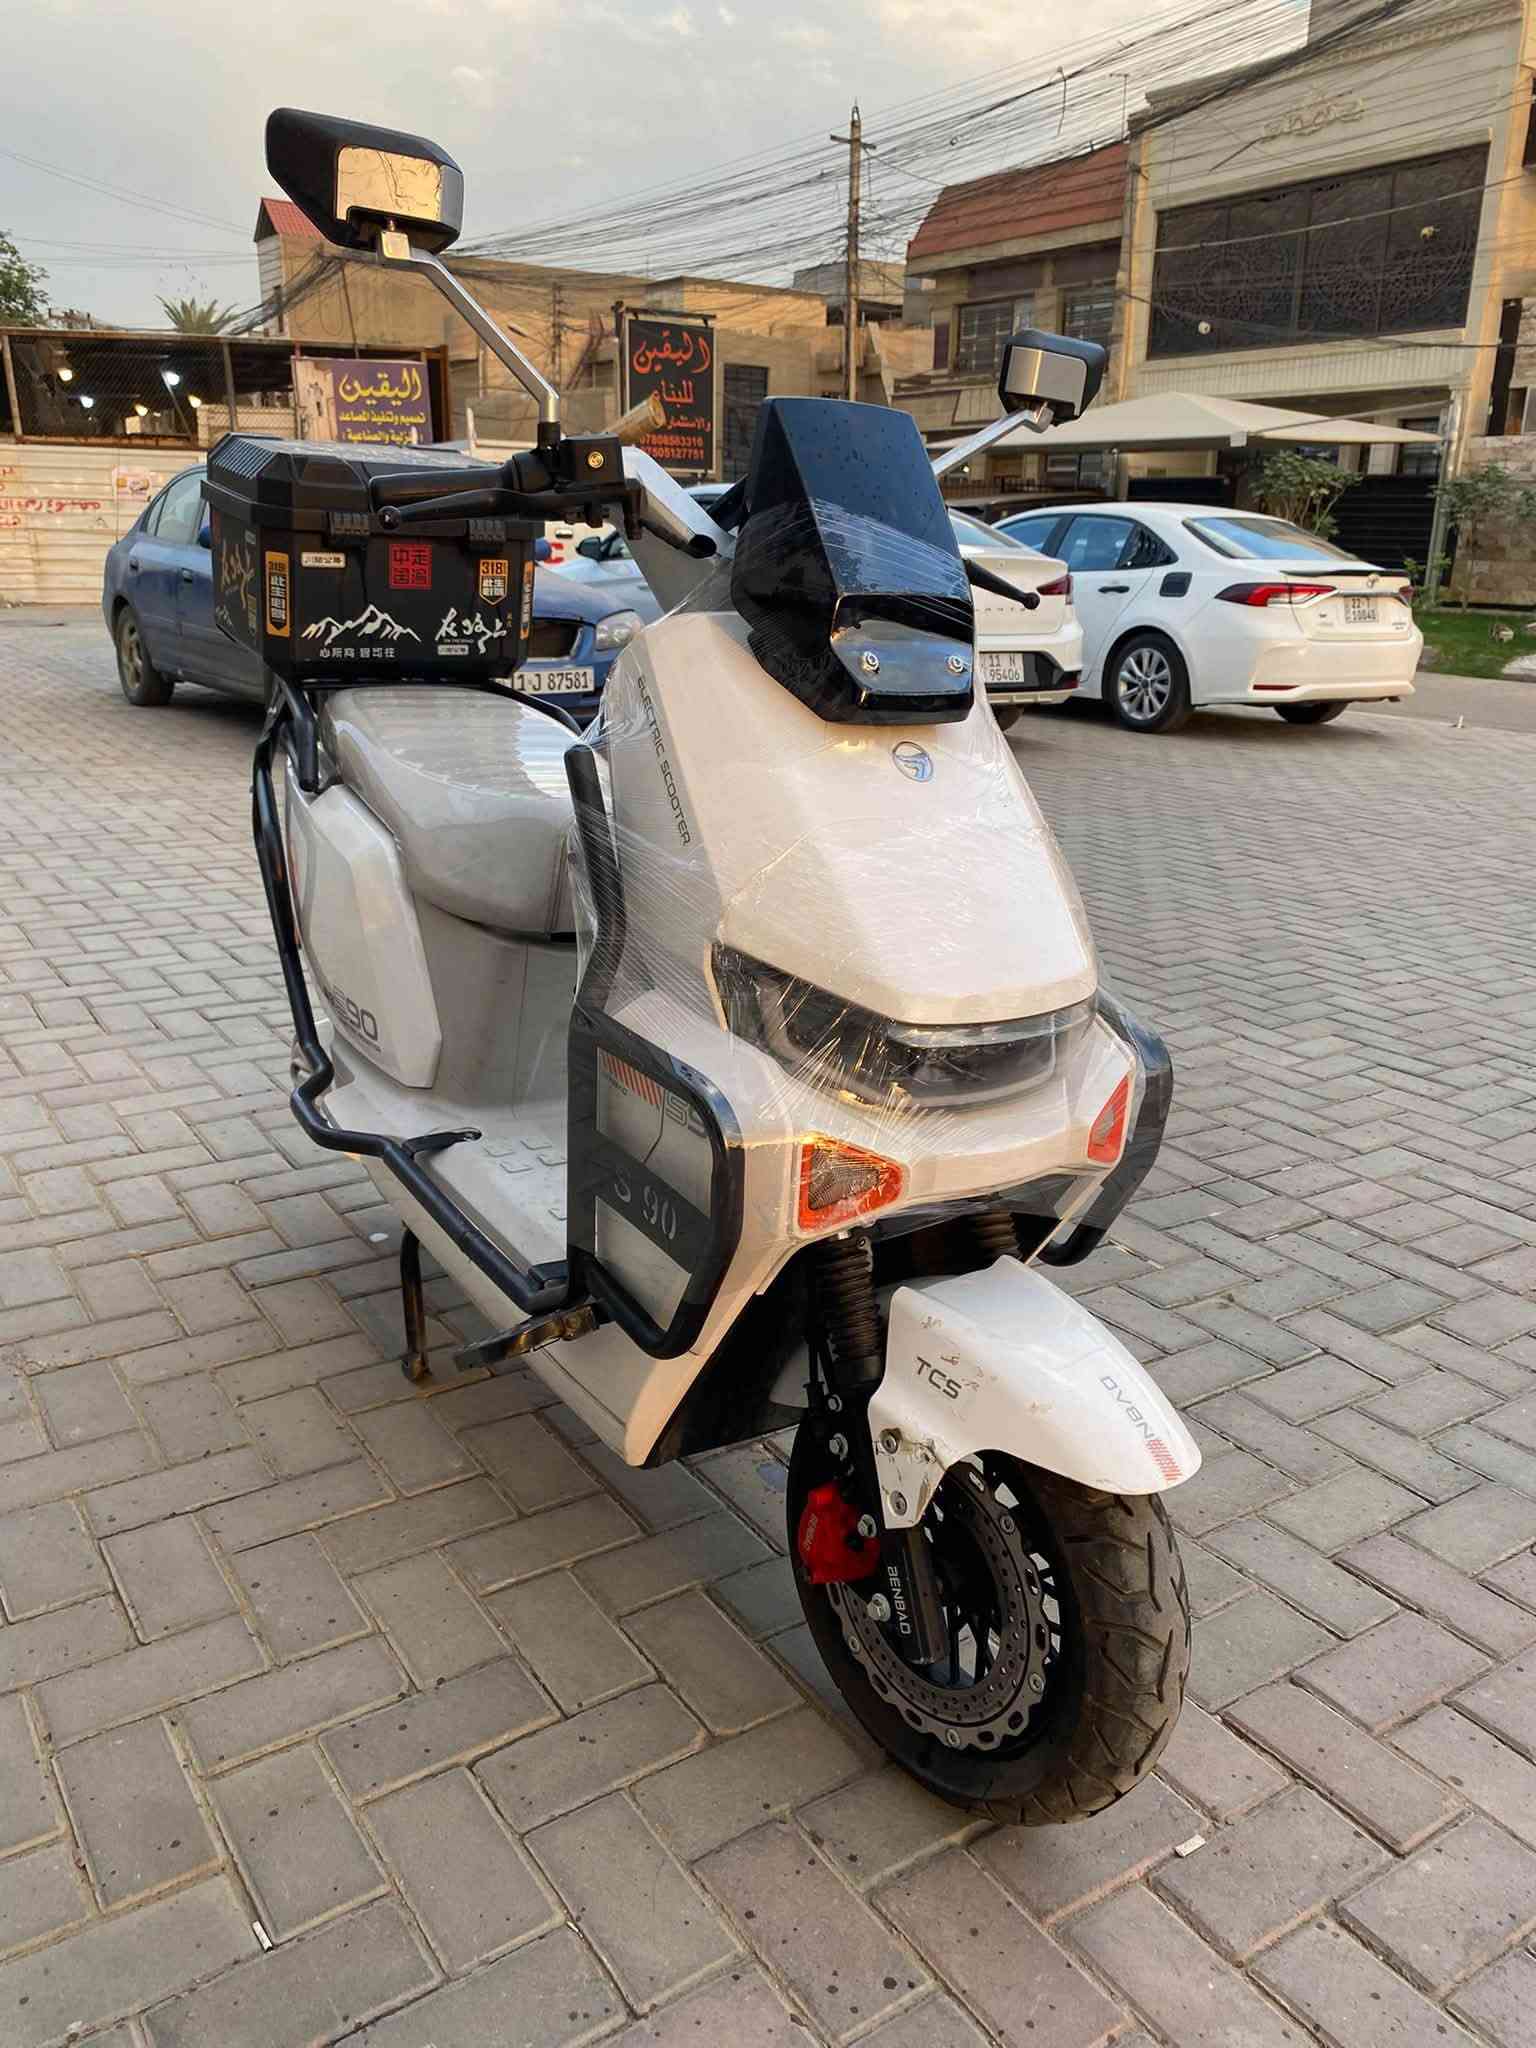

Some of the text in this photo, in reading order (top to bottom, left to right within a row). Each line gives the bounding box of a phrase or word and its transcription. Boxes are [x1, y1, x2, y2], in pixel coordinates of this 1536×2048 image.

[633, 330, 711, 375] اليقين
[339, 367, 422, 407] اليقين
[481, 562, 504, 575] 318
[989, 654, 1001, 667] 11
[517, 671, 590, 692] 1 J 87581
[660, 760, 692, 847] SCOOTER
[643, 1185, 677, 1240] 90
[916, 1356, 962, 1399] TCS
